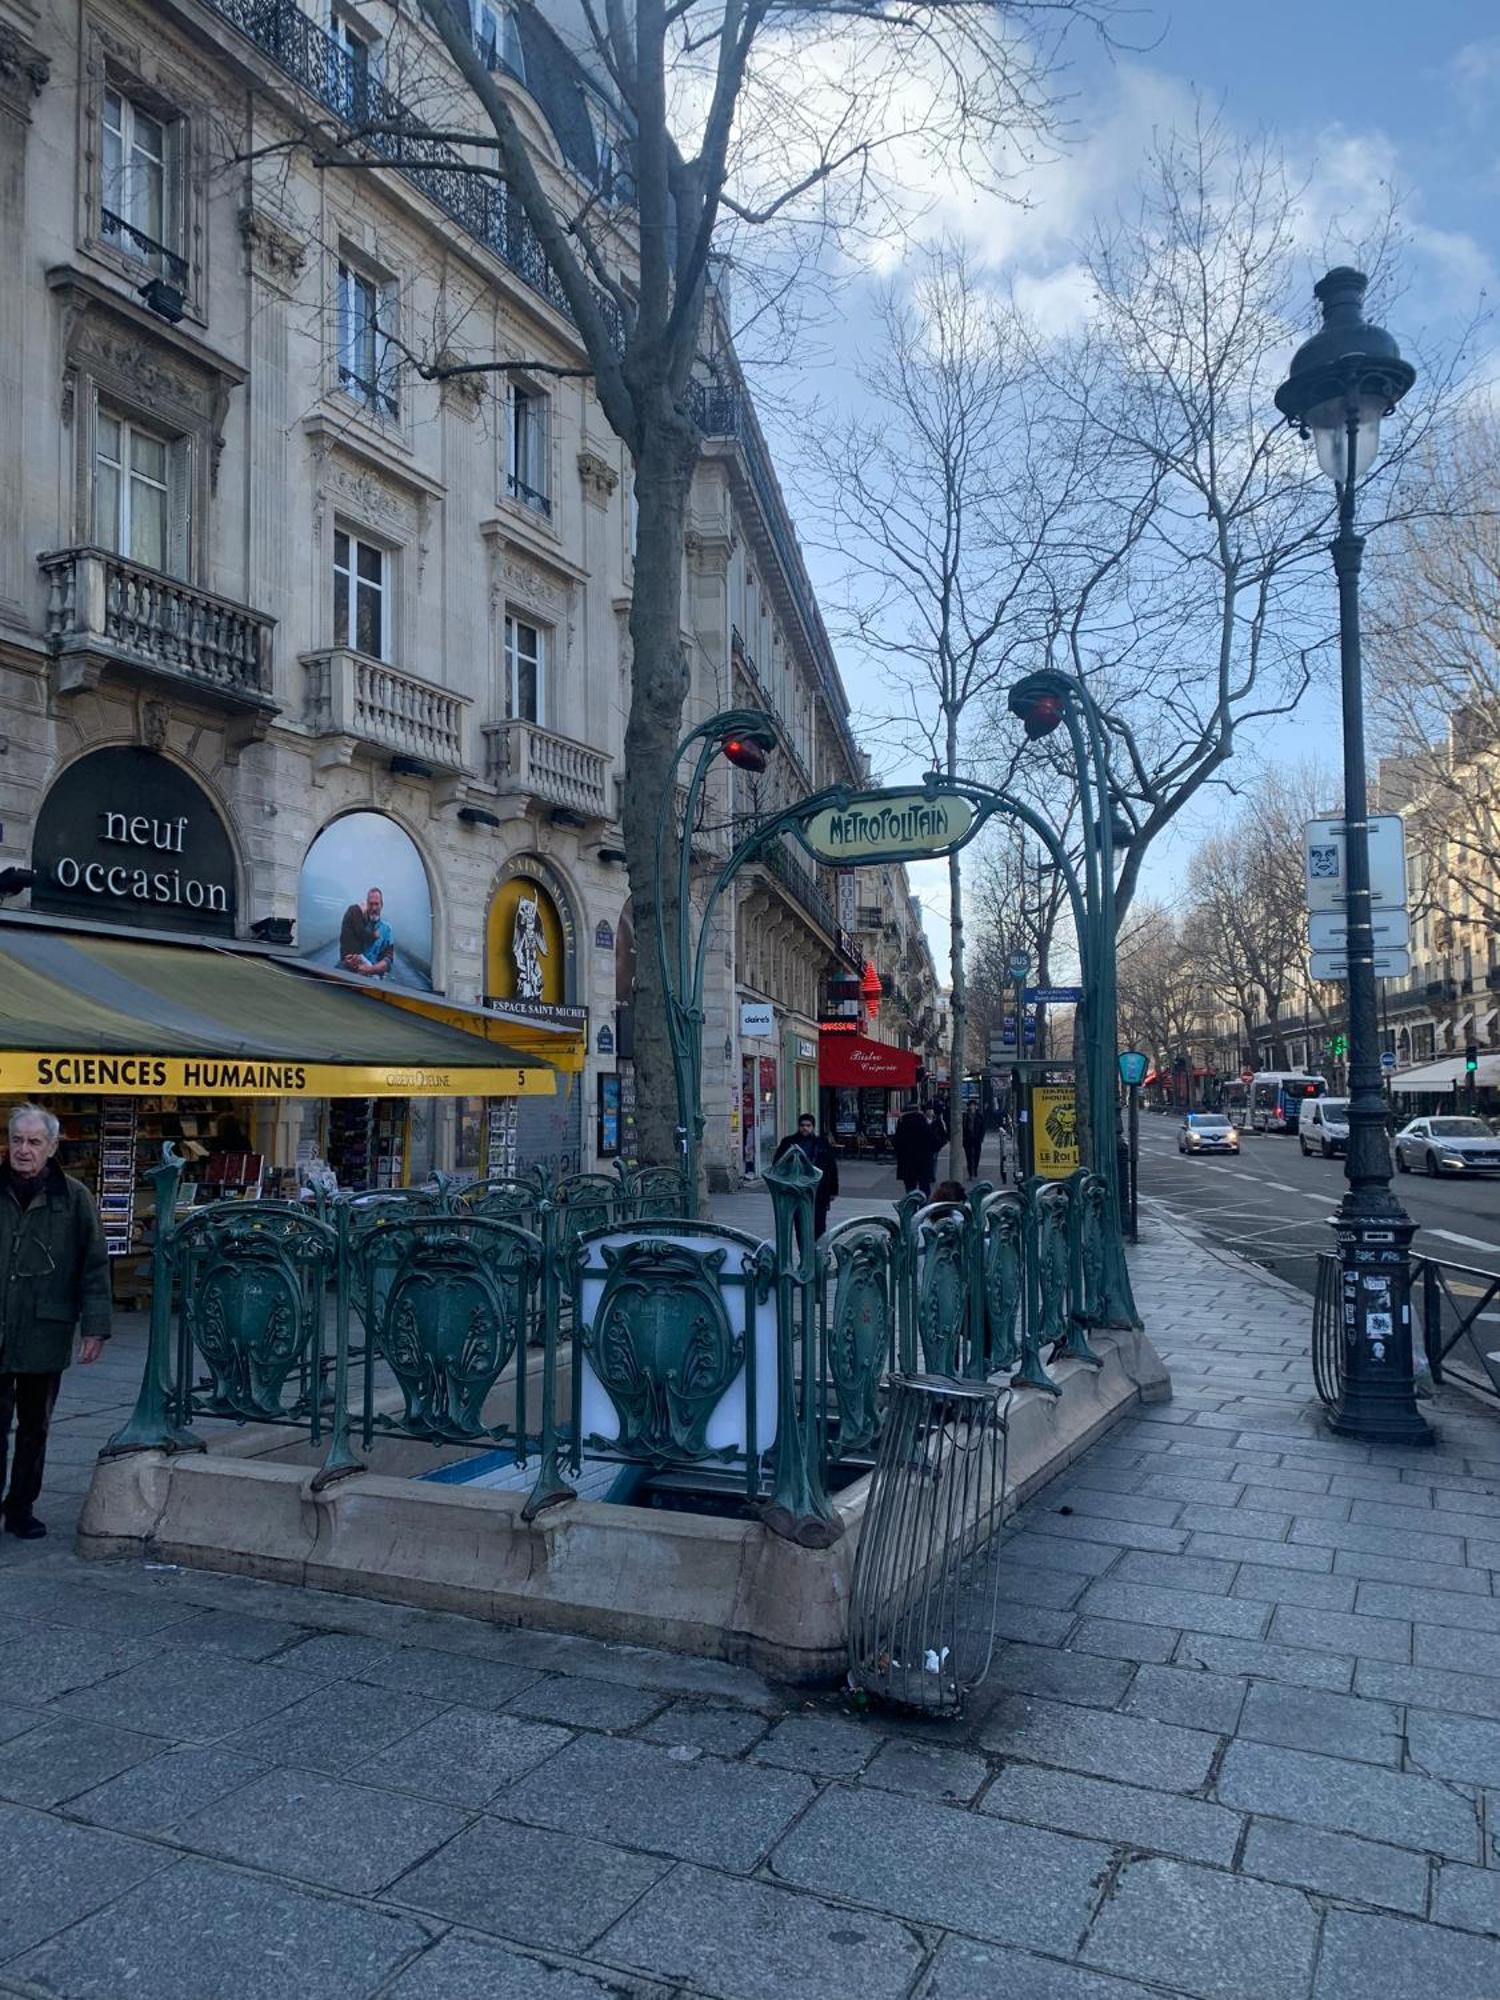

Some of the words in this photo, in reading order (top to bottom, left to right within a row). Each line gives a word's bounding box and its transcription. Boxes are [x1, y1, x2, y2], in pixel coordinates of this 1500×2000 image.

[104, 811, 189, 854] neuf
[830, 804, 949, 846] METROPOLITAIN
[57, 857, 230, 912] occasion
[1010, 956, 1028, 966] BUS
[492, 1000, 527, 1013] ESPACE
[528, 1005, 553, 1015] SAINT
[555, 1008, 588, 1018] MICHEL
[744, 1014, 770, 1024] claire's
[849, 1050, 882, 1062] Bistro
[37, 1058, 167, 1086] SCIENCES
[184, 1063, 307, 1089] HUMAINES
[517, 1070, 526, 1086] 5
[1039, 1152, 1051, 1161] LE
[1052, 1150, 1071, 1164] ROI
